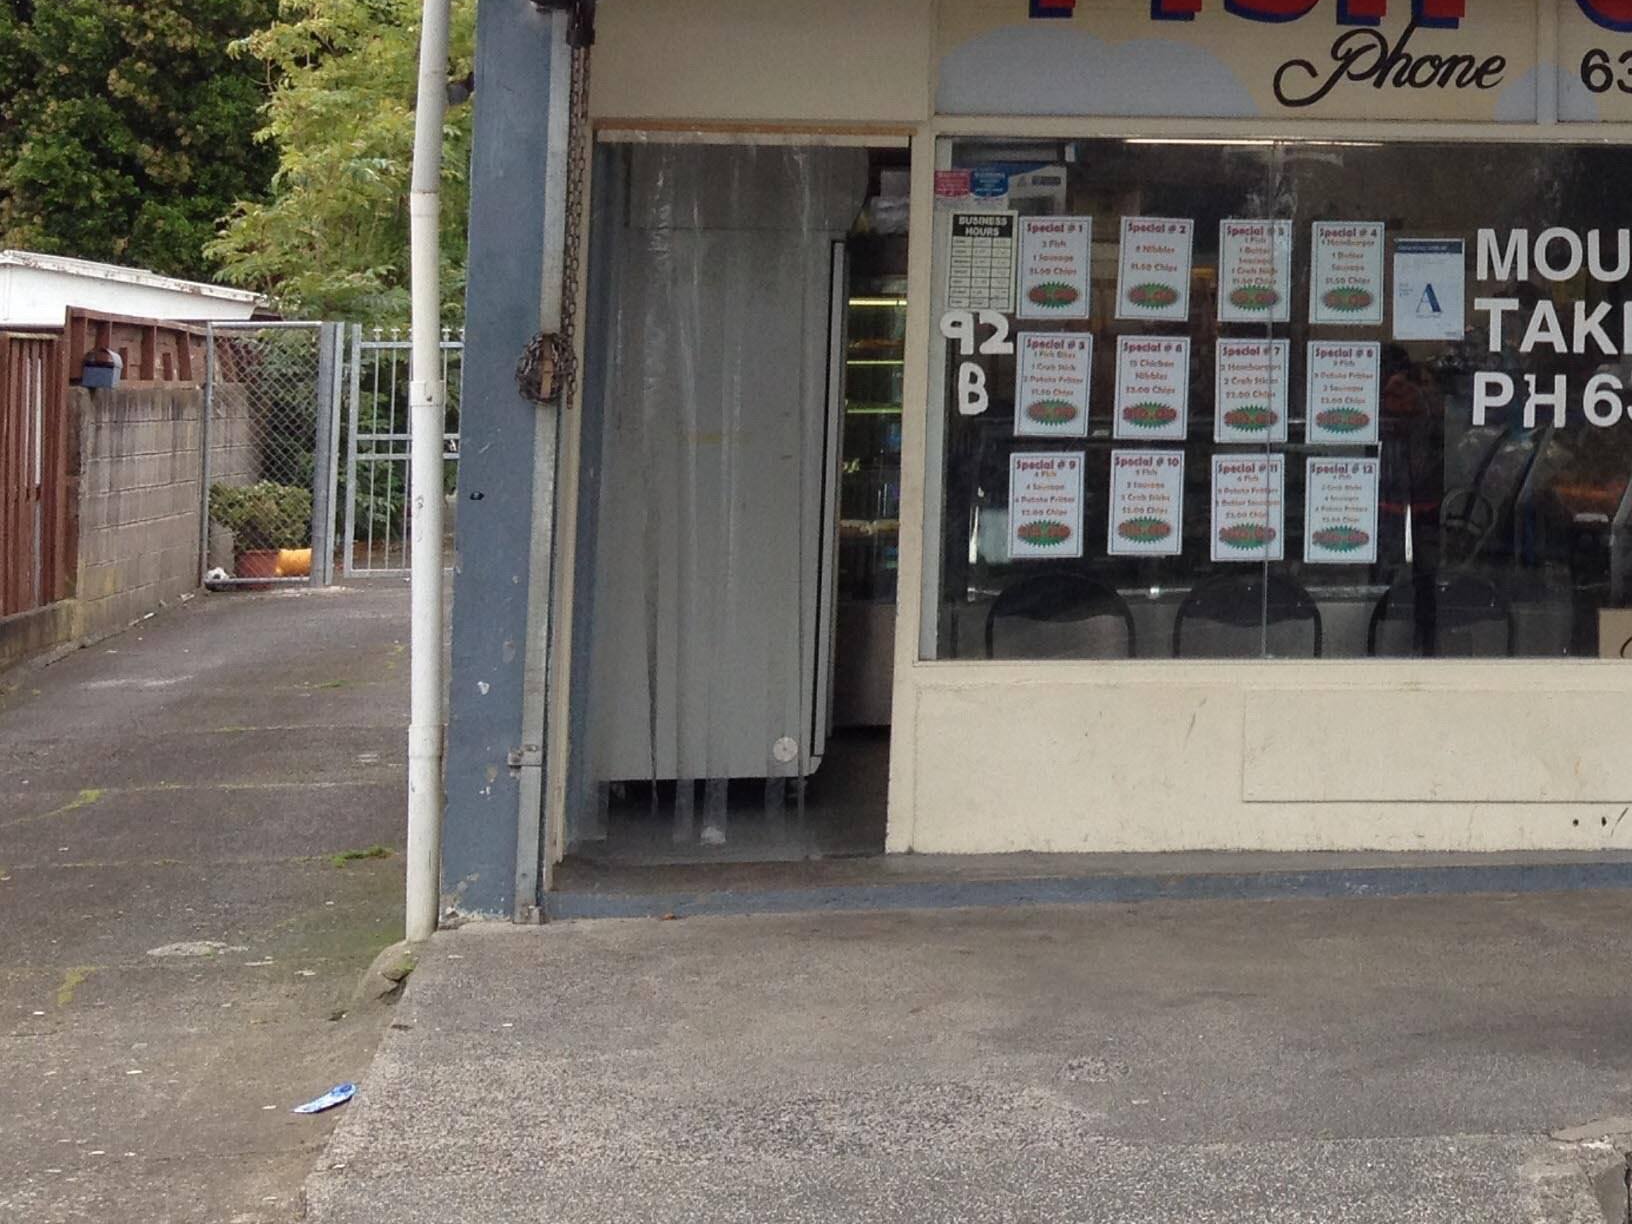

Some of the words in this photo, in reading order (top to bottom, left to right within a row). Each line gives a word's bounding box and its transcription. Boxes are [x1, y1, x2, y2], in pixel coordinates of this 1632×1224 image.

[1273, 16, 1506, 107] Phone
[959, 216, 1008, 226] BUSINESS
[965, 227, 999, 236] HOURS
[1415, 283, 1443, 313] A
[941, 309, 1014, 355] 92
[959, 362, 989, 415] B
[1472, 371, 1566, 428] PH
